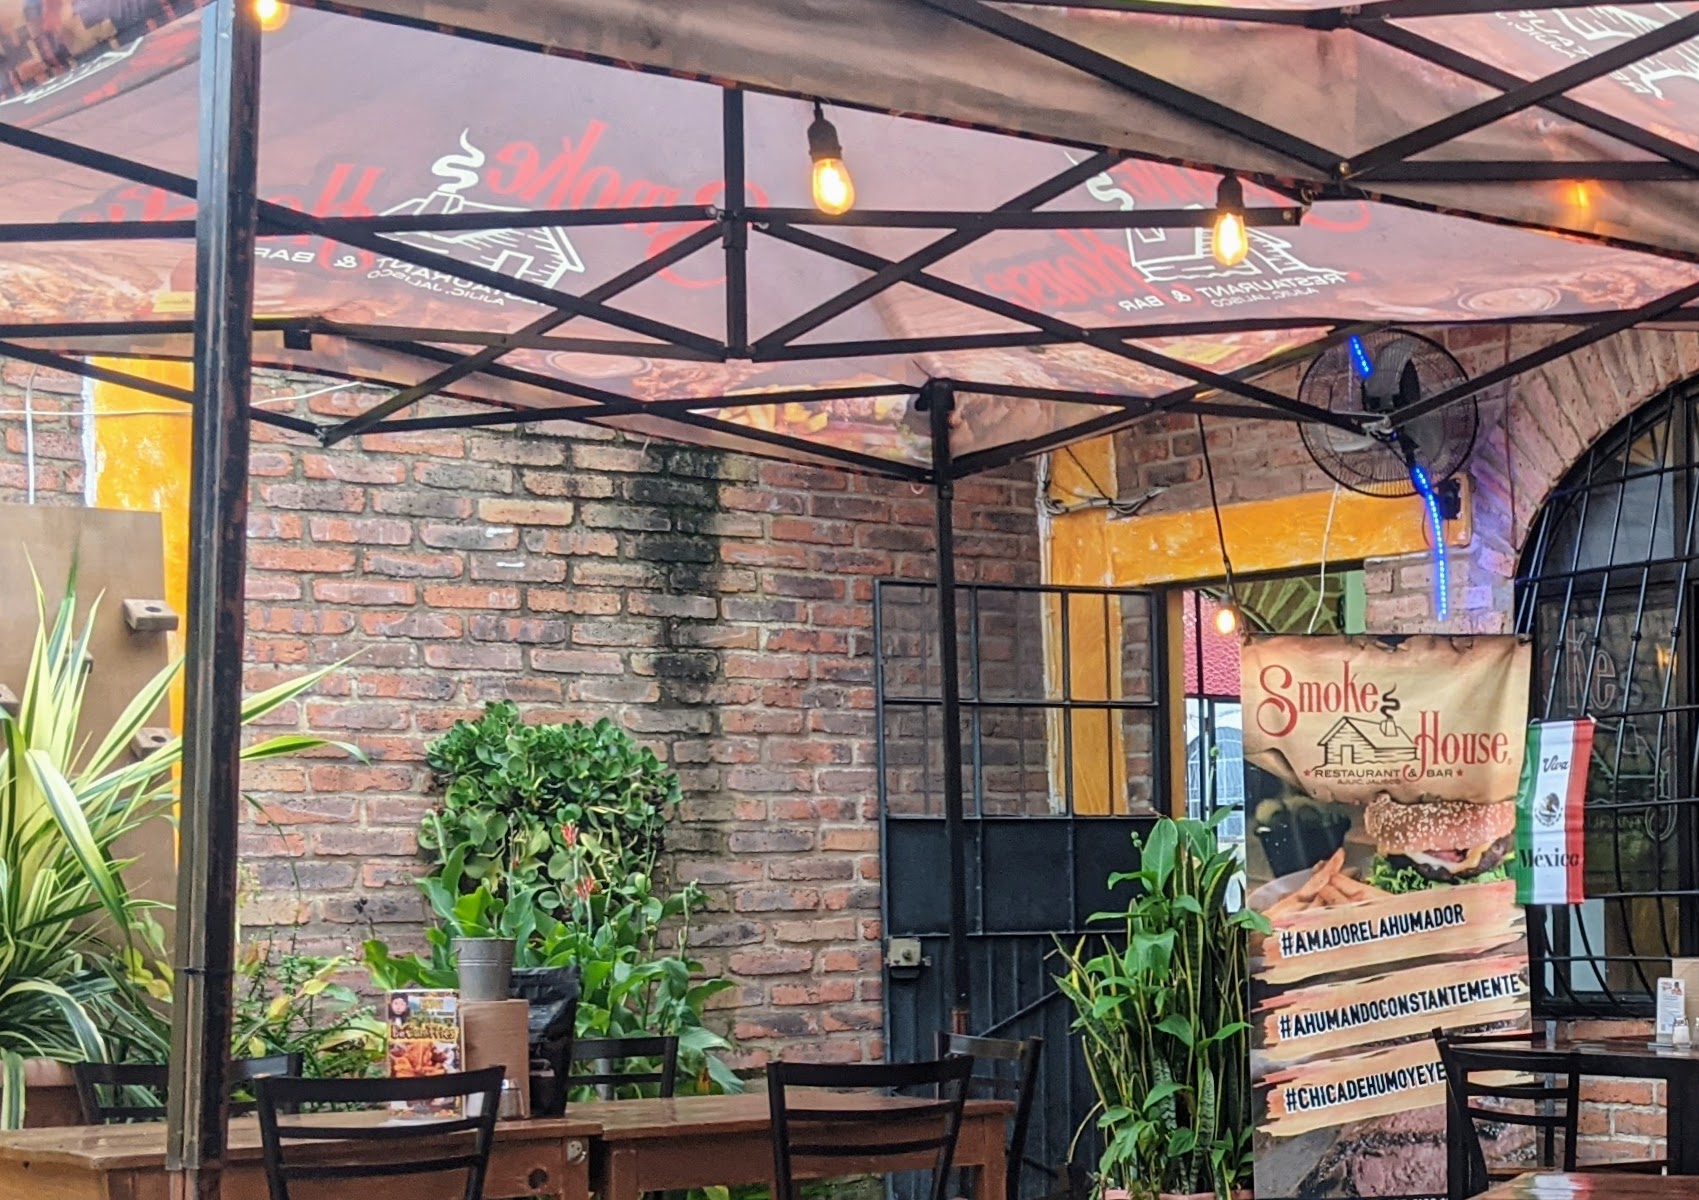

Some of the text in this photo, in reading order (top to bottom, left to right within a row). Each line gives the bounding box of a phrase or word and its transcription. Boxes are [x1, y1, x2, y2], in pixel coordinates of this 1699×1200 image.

[1256, 660, 1379, 738] Smoke
[1402, 710, 1509, 782] House
[1543, 755, 1570, 773] Viva
[1314, 768, 1453, 778] RESTAURANT & BAR
[1518, 847, 1581, 870] México
[1281, 903, 1466, 956] #AMADORELAHUMADOR
[1279, 972, 1521, 1040] #AHUMANDOCONSTANTEMENTE
